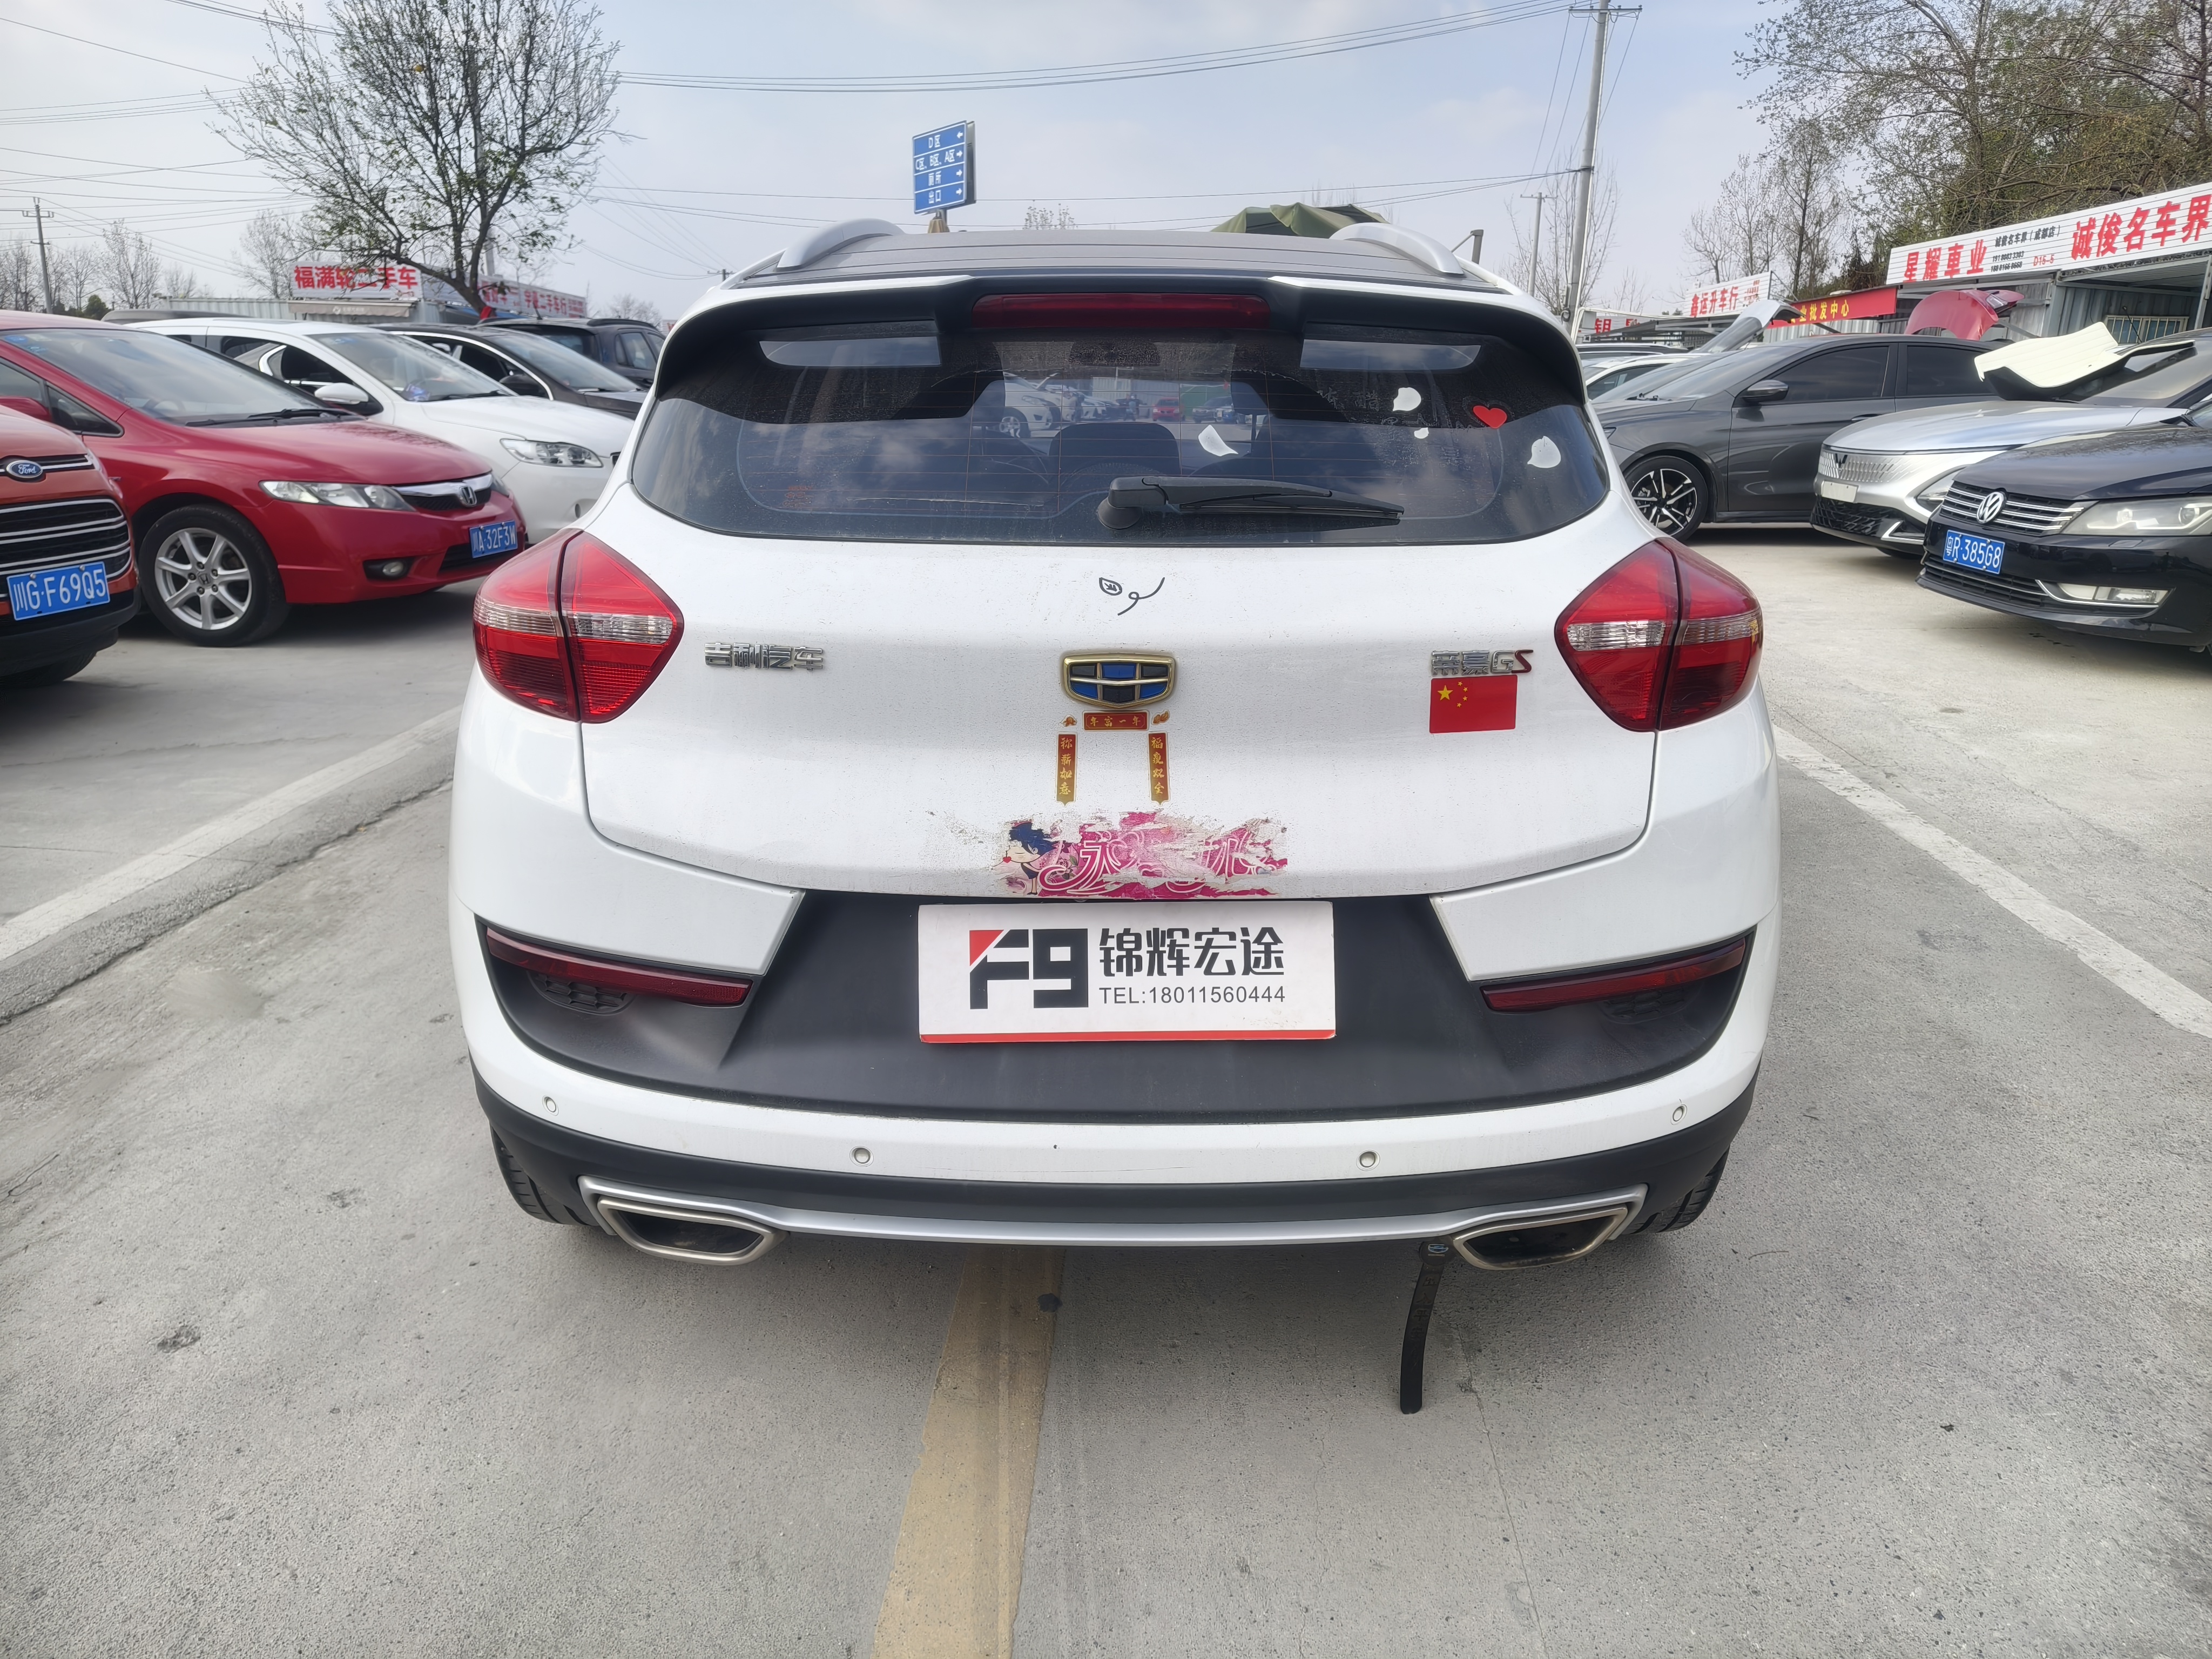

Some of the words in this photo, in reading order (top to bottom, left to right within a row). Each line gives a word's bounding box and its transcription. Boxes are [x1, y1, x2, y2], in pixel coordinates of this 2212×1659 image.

[928, 134, 941, 149] D区
[928, 190, 941, 204] 出口
[2072, 194, 2212, 260] 诚俊名车界
[2033, 254, 2055, 266] D15-5
[1791, 299, 1849, 323] 业批发中心
[18, 463, 37, 475] Ford
[704, 642, 824, 671] 吉利汽车
[1098, 926, 1284, 977] 锦辉宏途
[1098, 985, 1285, 1004] TEL:18011560444
